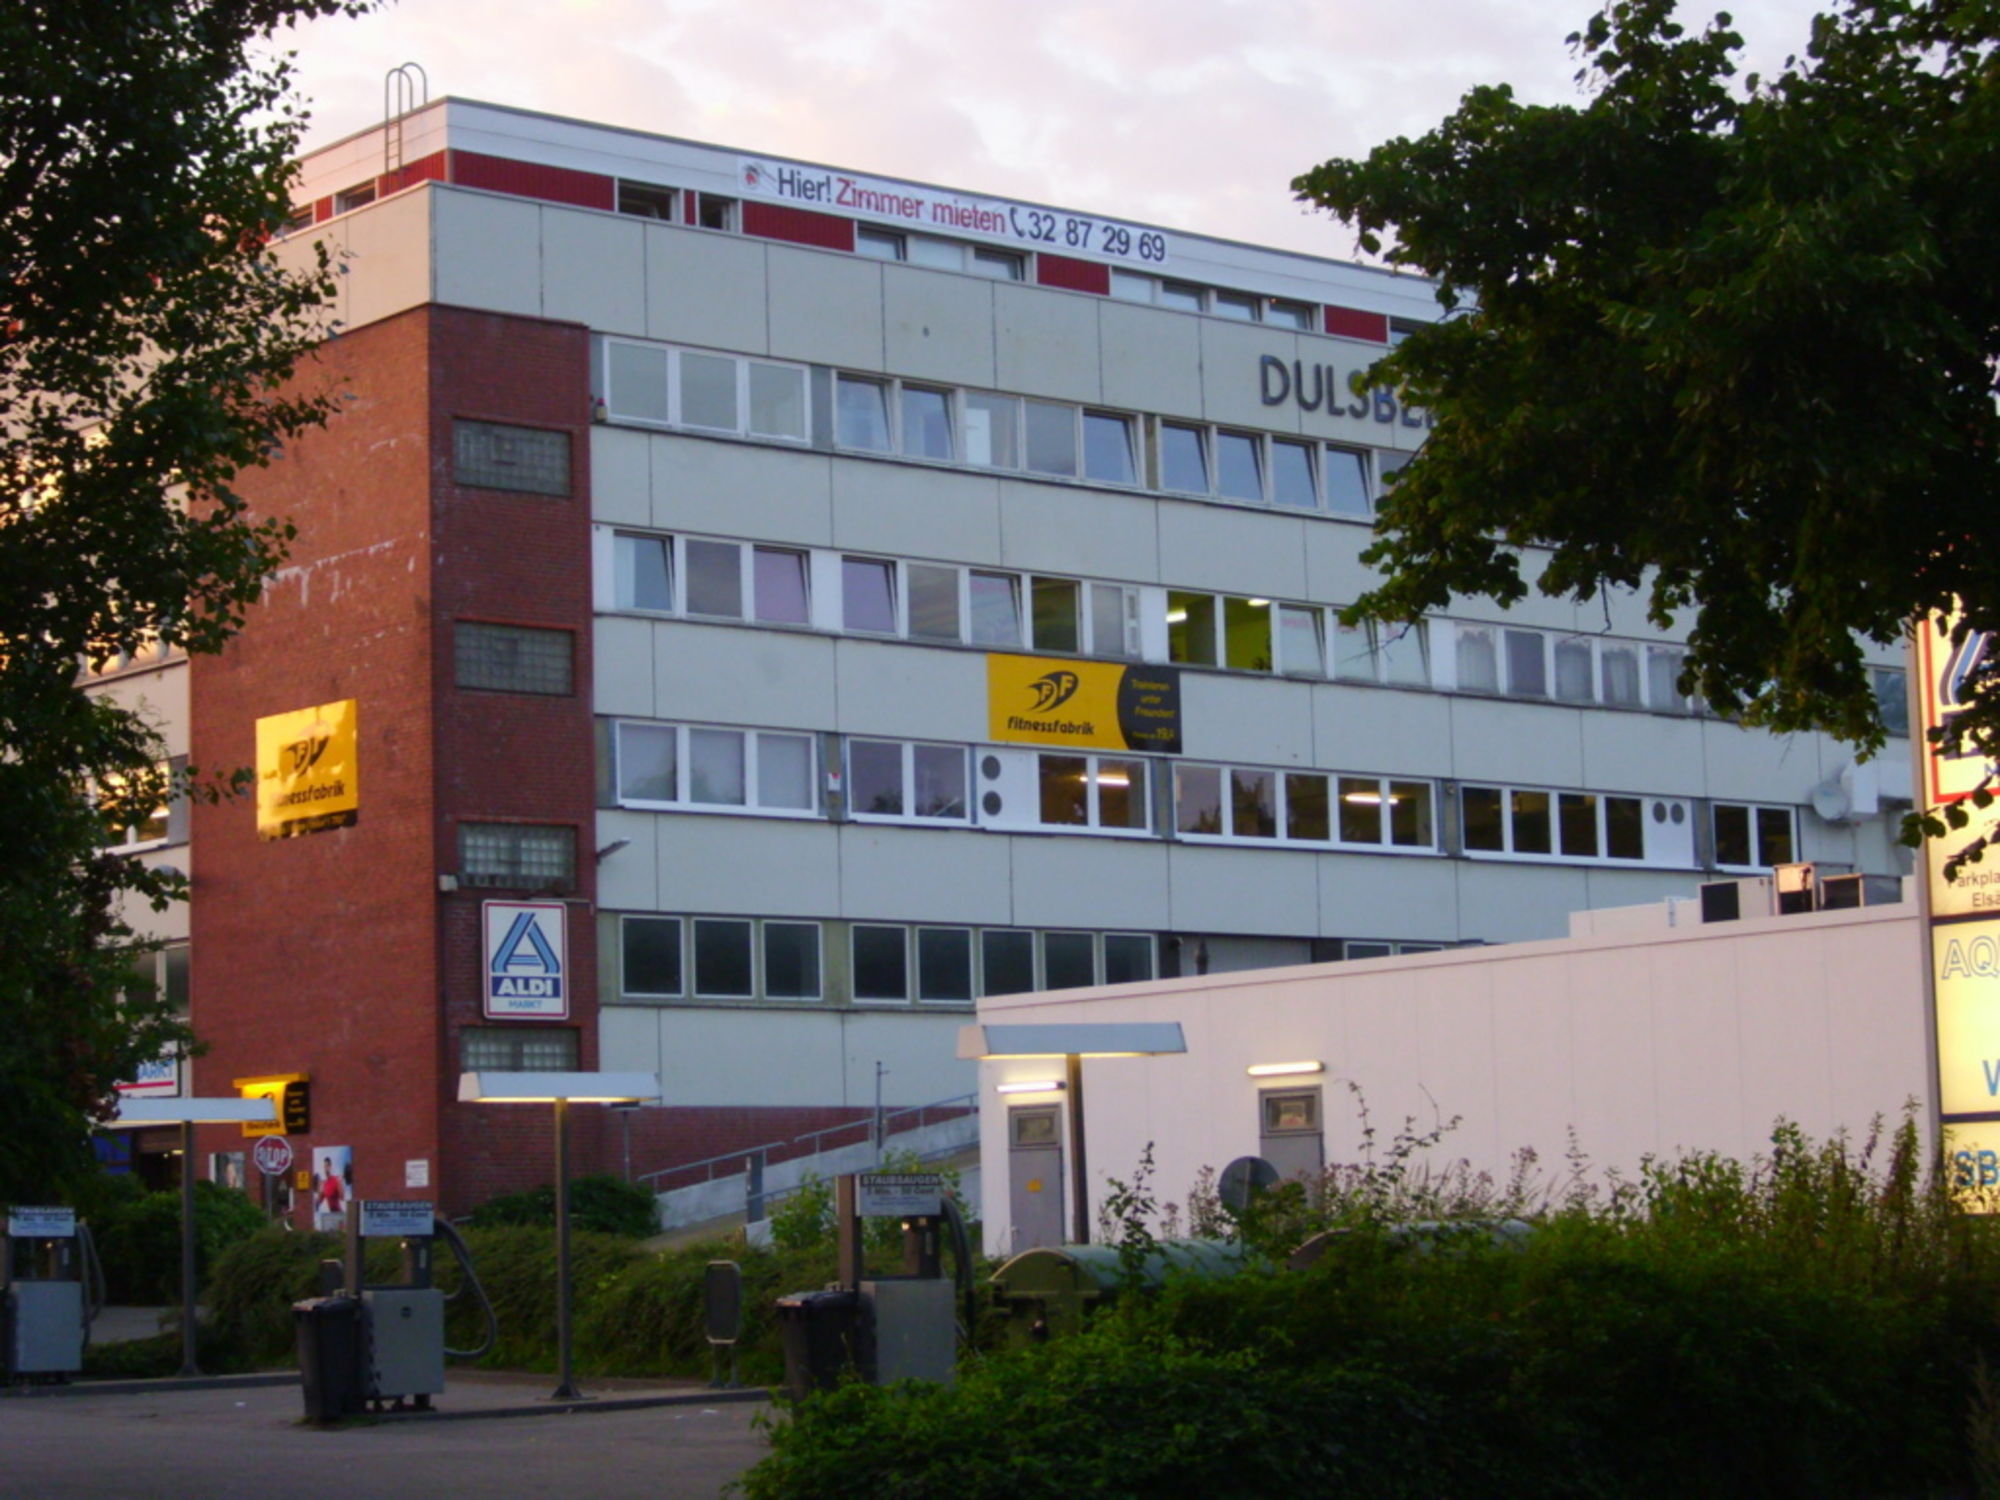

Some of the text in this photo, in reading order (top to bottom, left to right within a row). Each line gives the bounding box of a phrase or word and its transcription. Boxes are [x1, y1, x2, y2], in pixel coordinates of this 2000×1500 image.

[778, 167, 1165, 262] Hier! Zimmer mieten 32 87 29 69
[1260, 354, 1434, 430] DULSB
[1007, 715, 1095, 736] fitnessfabrik
[1942, 935, 2000, 980] AQ
[497, 978, 554, 996] ALDI
[138, 1057, 176, 1079] ARKT
[257, 1146, 288, 1167] STOP
